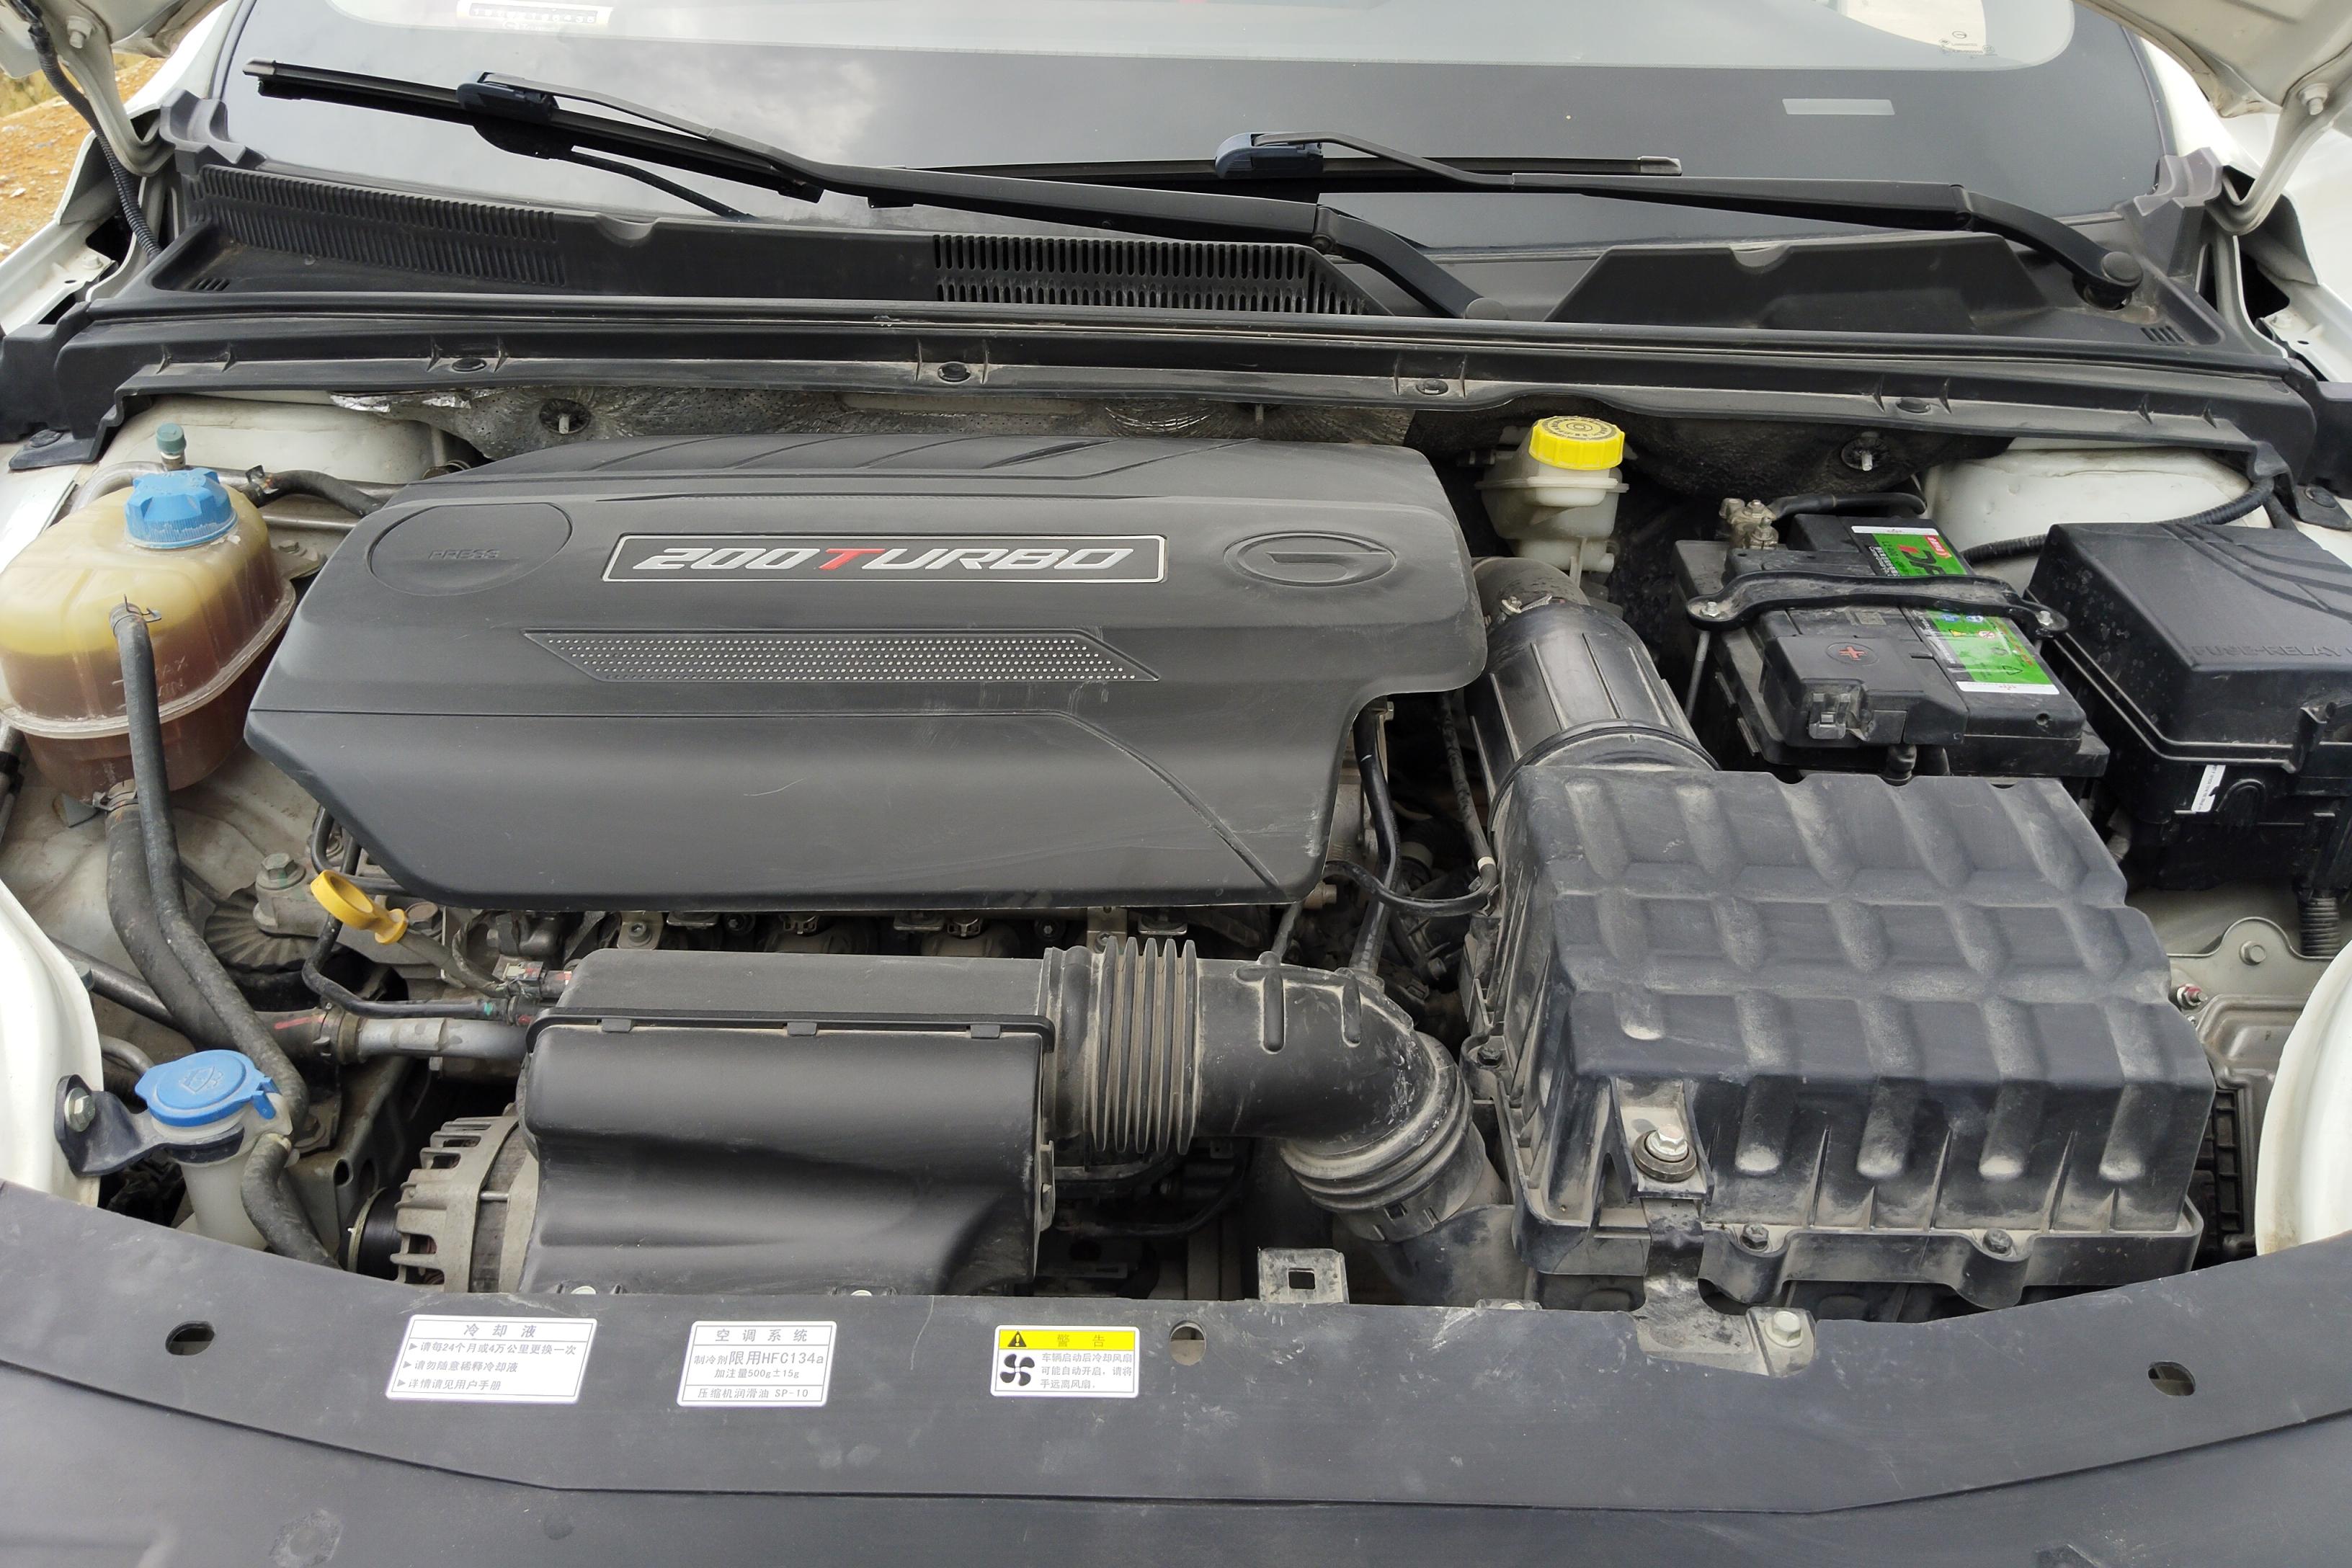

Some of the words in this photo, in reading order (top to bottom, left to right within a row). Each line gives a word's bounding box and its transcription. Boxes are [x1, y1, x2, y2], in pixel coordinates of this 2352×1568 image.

[428, 549, 500, 560] PRESS
[632, 548, 1134, 571] 200TURBO
[419, 1342, 577, 1355] 请每24个月或4万公里更换一次
[1041, 1353, 1133, 1363] 车辆启动后冷却风扇
[414, 1360, 519, 1373] 请勿随意稀释冷却液
[408, 1378, 502, 1391] 详情请见用户手册
[698, 1388, 770, 1399] 压缩机润滑油
[775, 1389, 809, 1398] SP-10
